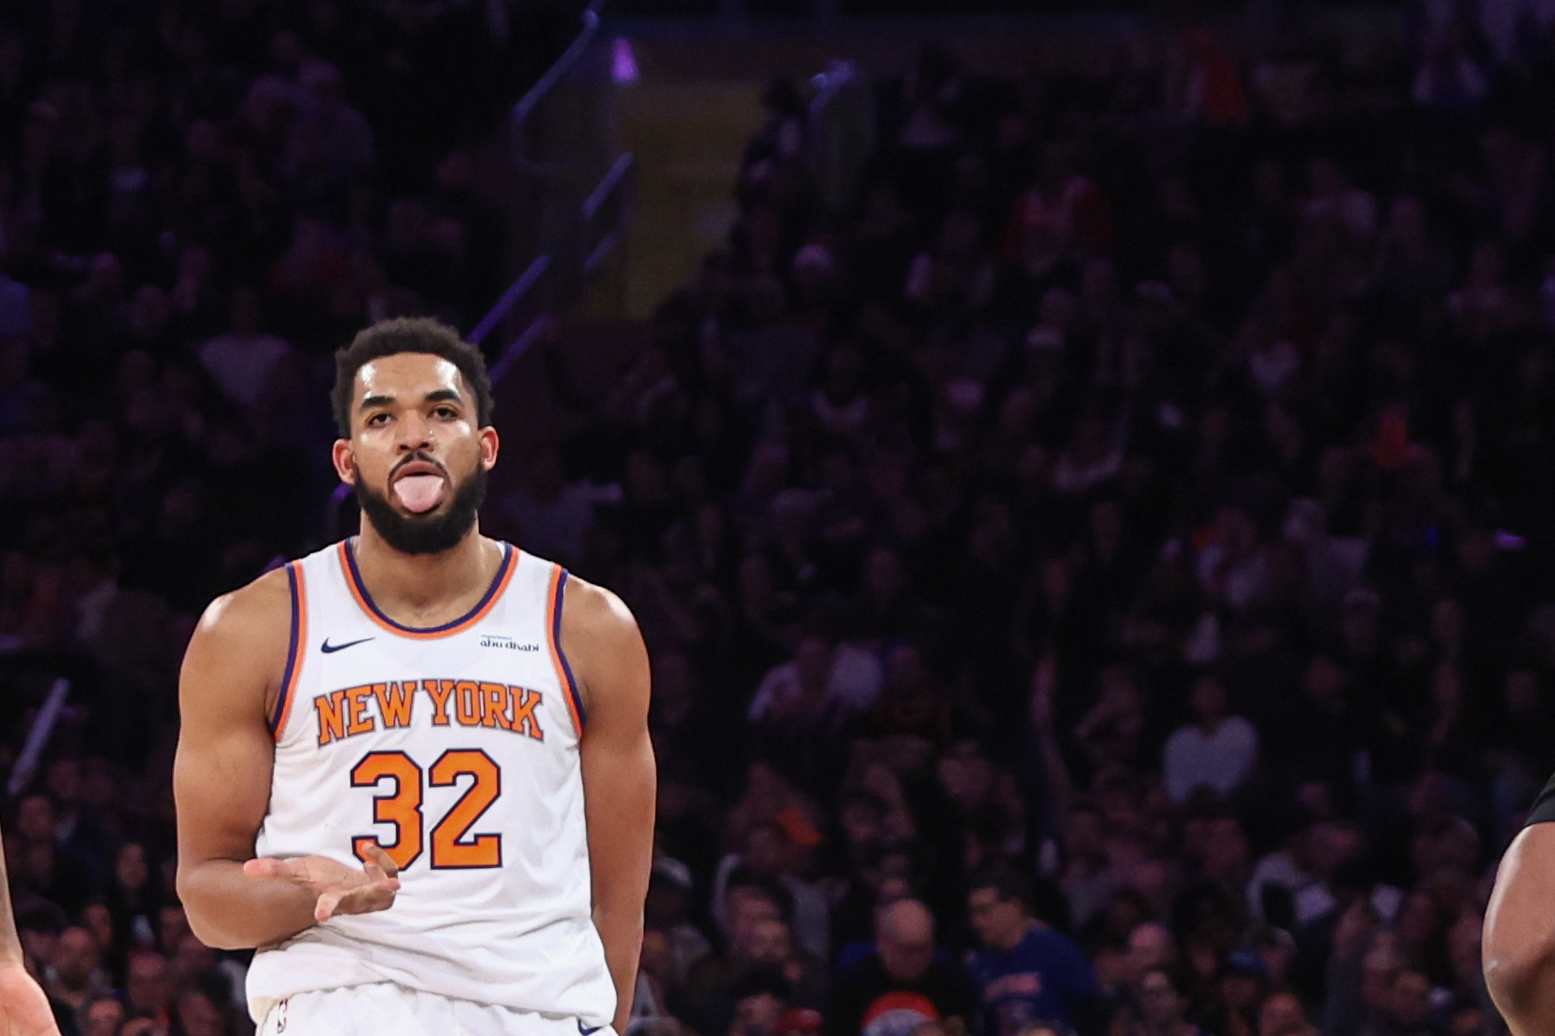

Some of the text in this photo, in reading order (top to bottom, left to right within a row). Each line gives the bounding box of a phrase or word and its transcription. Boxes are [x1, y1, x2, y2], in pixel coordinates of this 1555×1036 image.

[480, 638, 539, 651] abu dhabi
[313, 679, 544, 747] NEW YORK
[350, 748, 502, 871] 32
